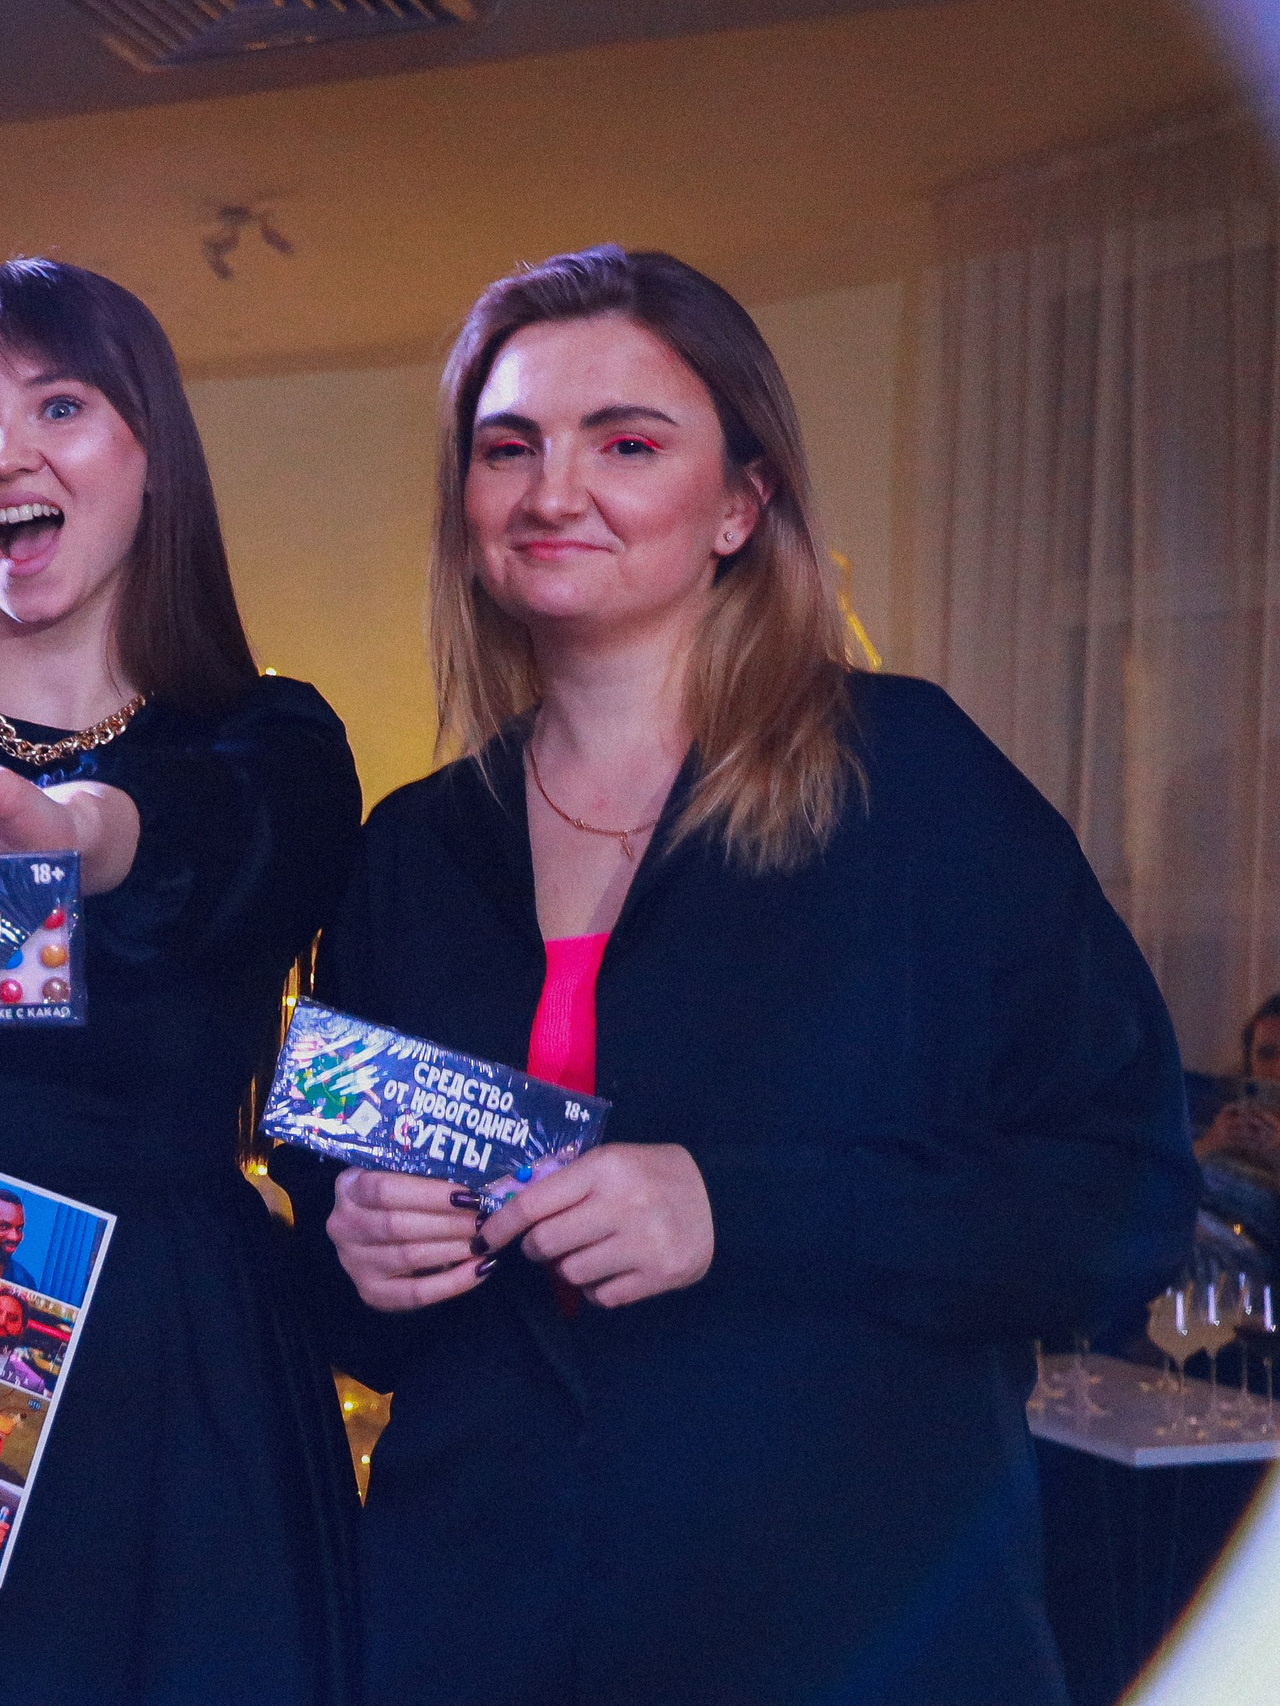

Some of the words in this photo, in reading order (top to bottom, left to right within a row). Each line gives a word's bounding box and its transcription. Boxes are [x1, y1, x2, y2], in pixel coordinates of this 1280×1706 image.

[30, 862, 65, 884] 18+
[16, 1007, 24, 1020] С
[27, 1006, 71, 1018] КАКАО
[414, 1062, 514, 1113] СРЕДСТВО
[383, 1079, 409, 1105] ОТ
[410, 1086, 530, 1148] НОВОГОДНЕЙ
[564, 1100, 590, 1122] 18+
[394, 1114, 492, 1173] СУЕТЫ
